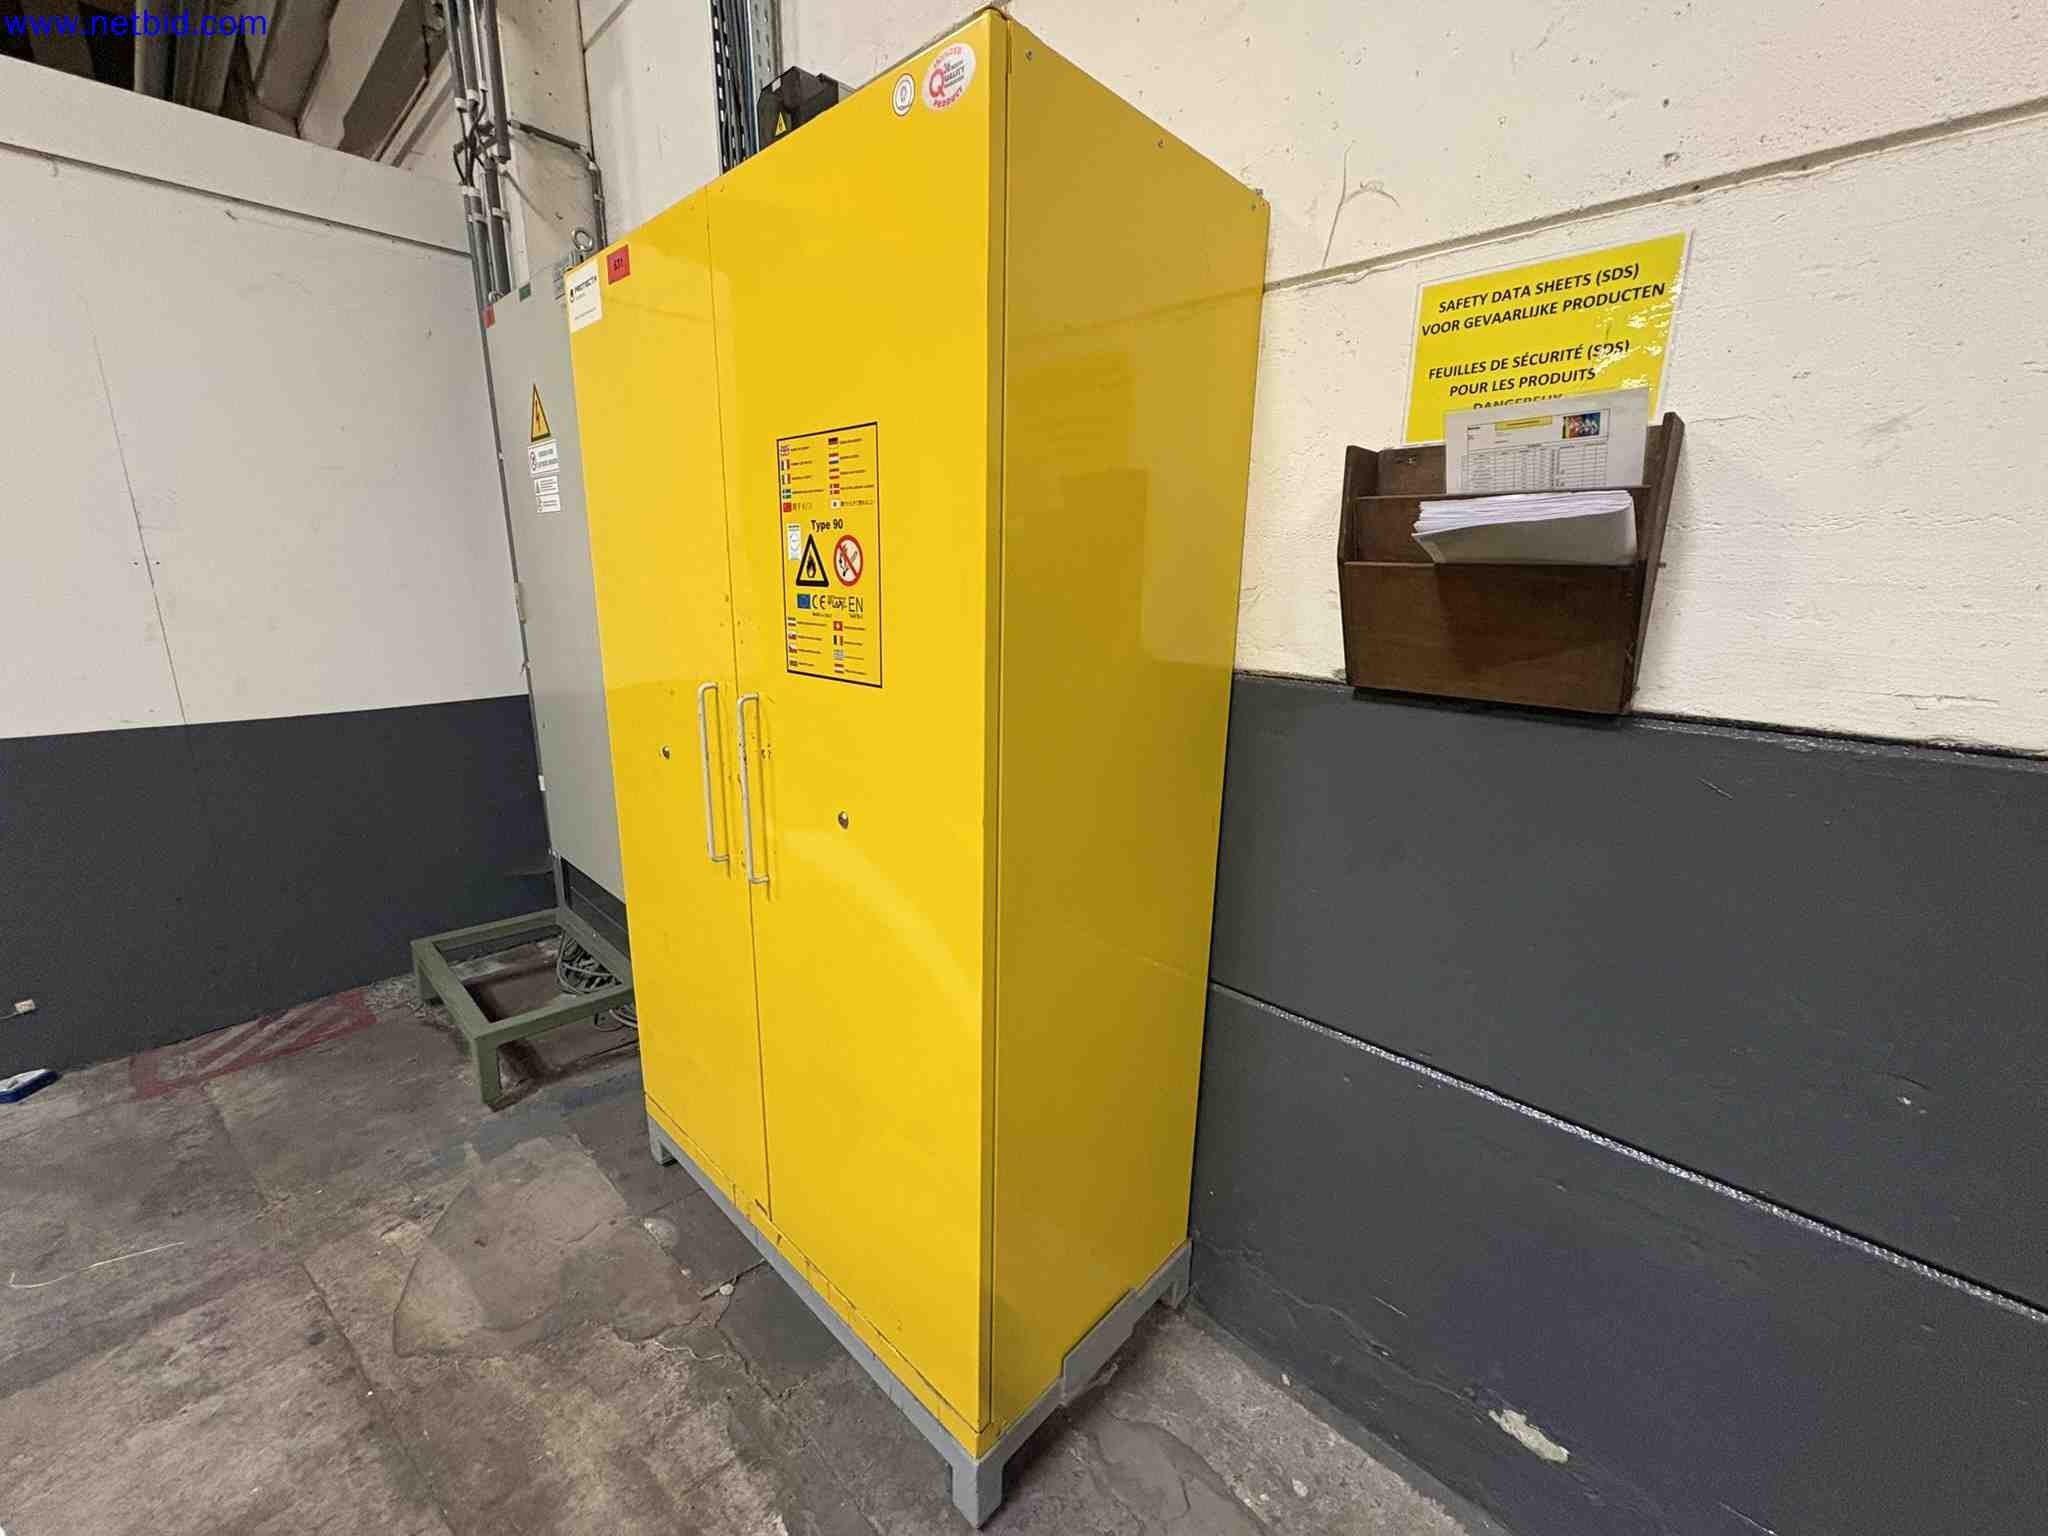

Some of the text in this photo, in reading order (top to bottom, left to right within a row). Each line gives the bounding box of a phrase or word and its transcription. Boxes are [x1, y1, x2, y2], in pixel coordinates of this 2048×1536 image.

[1438, 263, 1639, 313] SAFETY DATA SHEETS (SDS)
[1422, 283, 1665, 336] VOOR GEVAARLIJKE PRODUCTEN
[1428, 340, 1630, 379] FEUILLES DE SÉCURITÉ (SDS)
[1449, 368, 1596, 397] POUR LES PRODUITS
[811, 520, 830, 533] Type
[833, 518, 844, 530] 90
[812, 594, 826, 610] CE
[848, 596, 864, 613] EN
